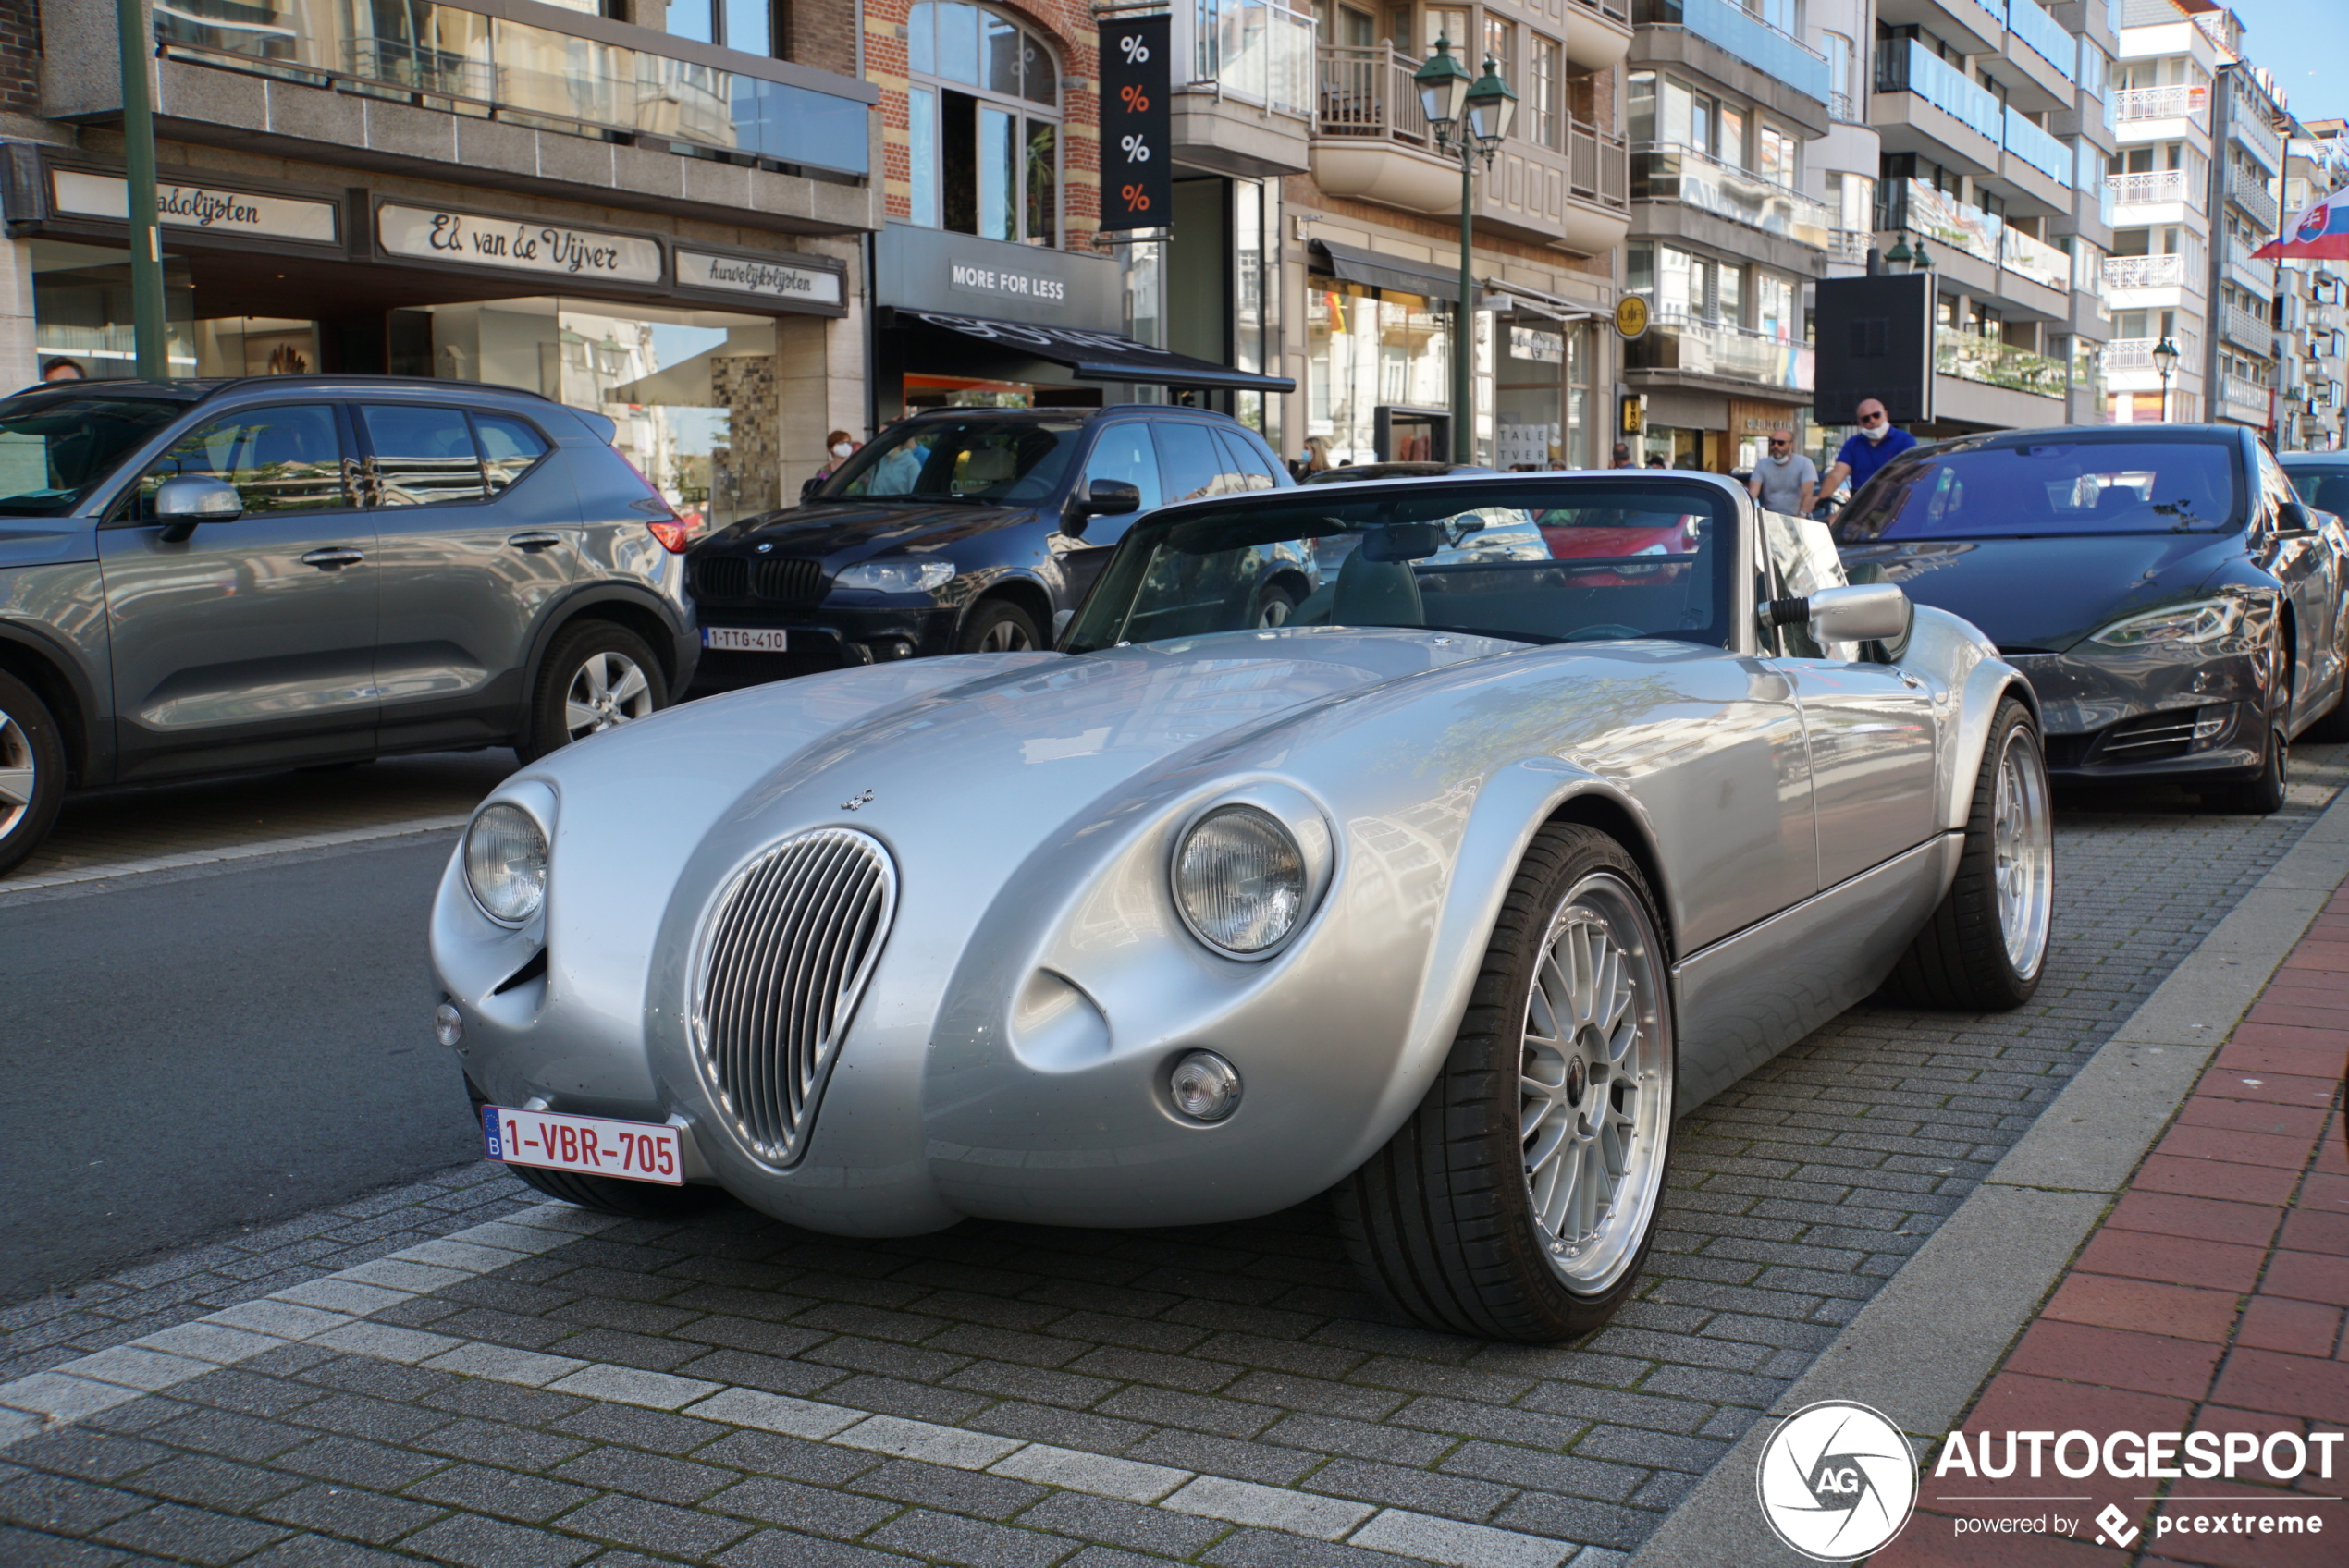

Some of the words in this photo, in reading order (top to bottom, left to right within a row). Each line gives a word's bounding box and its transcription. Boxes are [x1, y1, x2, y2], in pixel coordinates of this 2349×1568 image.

[1120, 34, 1150, 64] %
[1120, 84, 1150, 114] %
[1121, 134, 1150, 163] %
[157, 188, 260, 226] adolijsten
[1121, 183, 1150, 212] %
[429, 214, 463, 251] Ed
[473, 232, 507, 257] van
[512, 226, 537, 261] de
[541, 228, 618, 273] Vijver
[709, 259, 812, 294] huwelijkslijsten
[953, 265, 995, 289] MORE
[999, 274, 1028, 295] FOR
[1032, 279, 1064, 300] LESS
[712, 631, 782, 648] 1-TTG-410
[488, 1136, 500, 1156] B
[506, 1120, 674, 1175] 1-VBR-705
